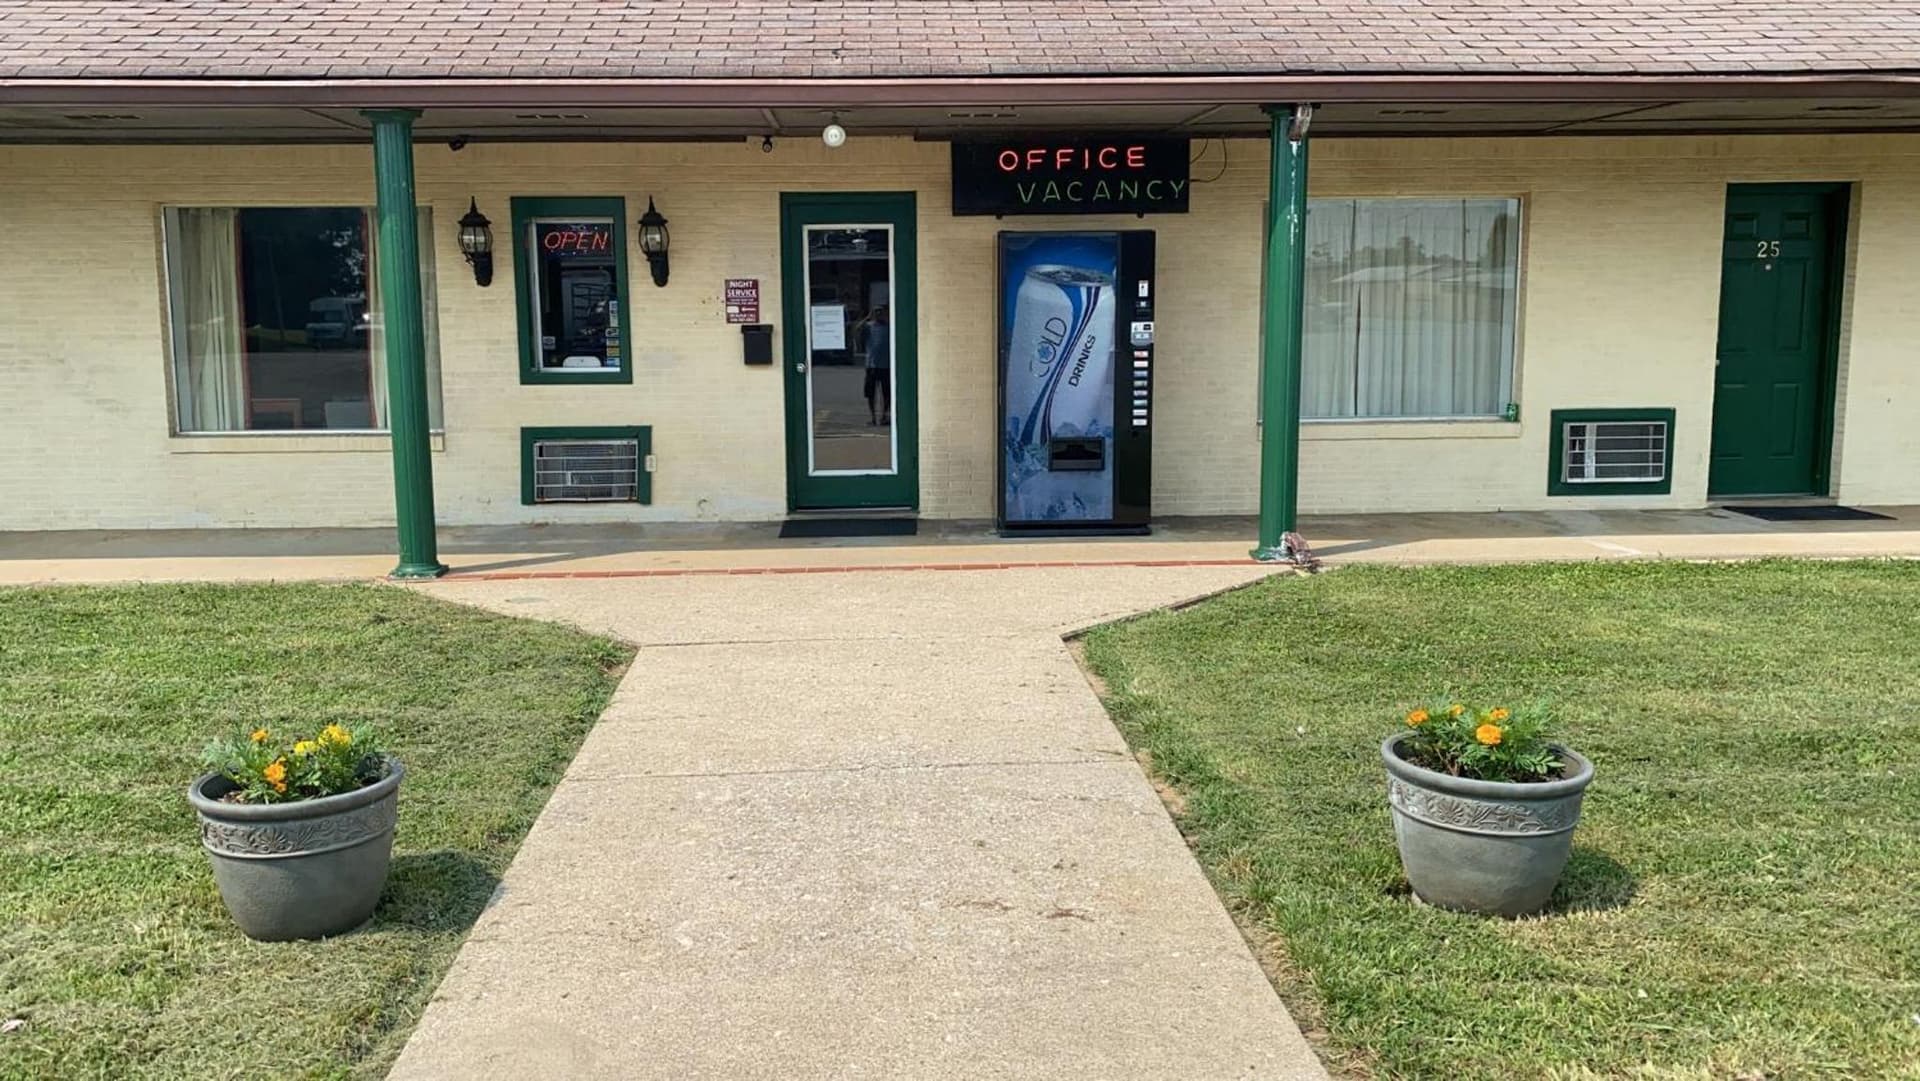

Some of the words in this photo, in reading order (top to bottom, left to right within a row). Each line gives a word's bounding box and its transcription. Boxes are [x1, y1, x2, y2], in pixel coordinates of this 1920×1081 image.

[999, 146, 1145, 172] OFFICE
[1016, 179, 1186, 204] VACANCY
[544, 231, 609, 250] OPEN
[1757, 240, 1780, 258] 25
[1028, 316, 1067, 378] COLD
[1068, 334, 1096, 387] DRINKS
